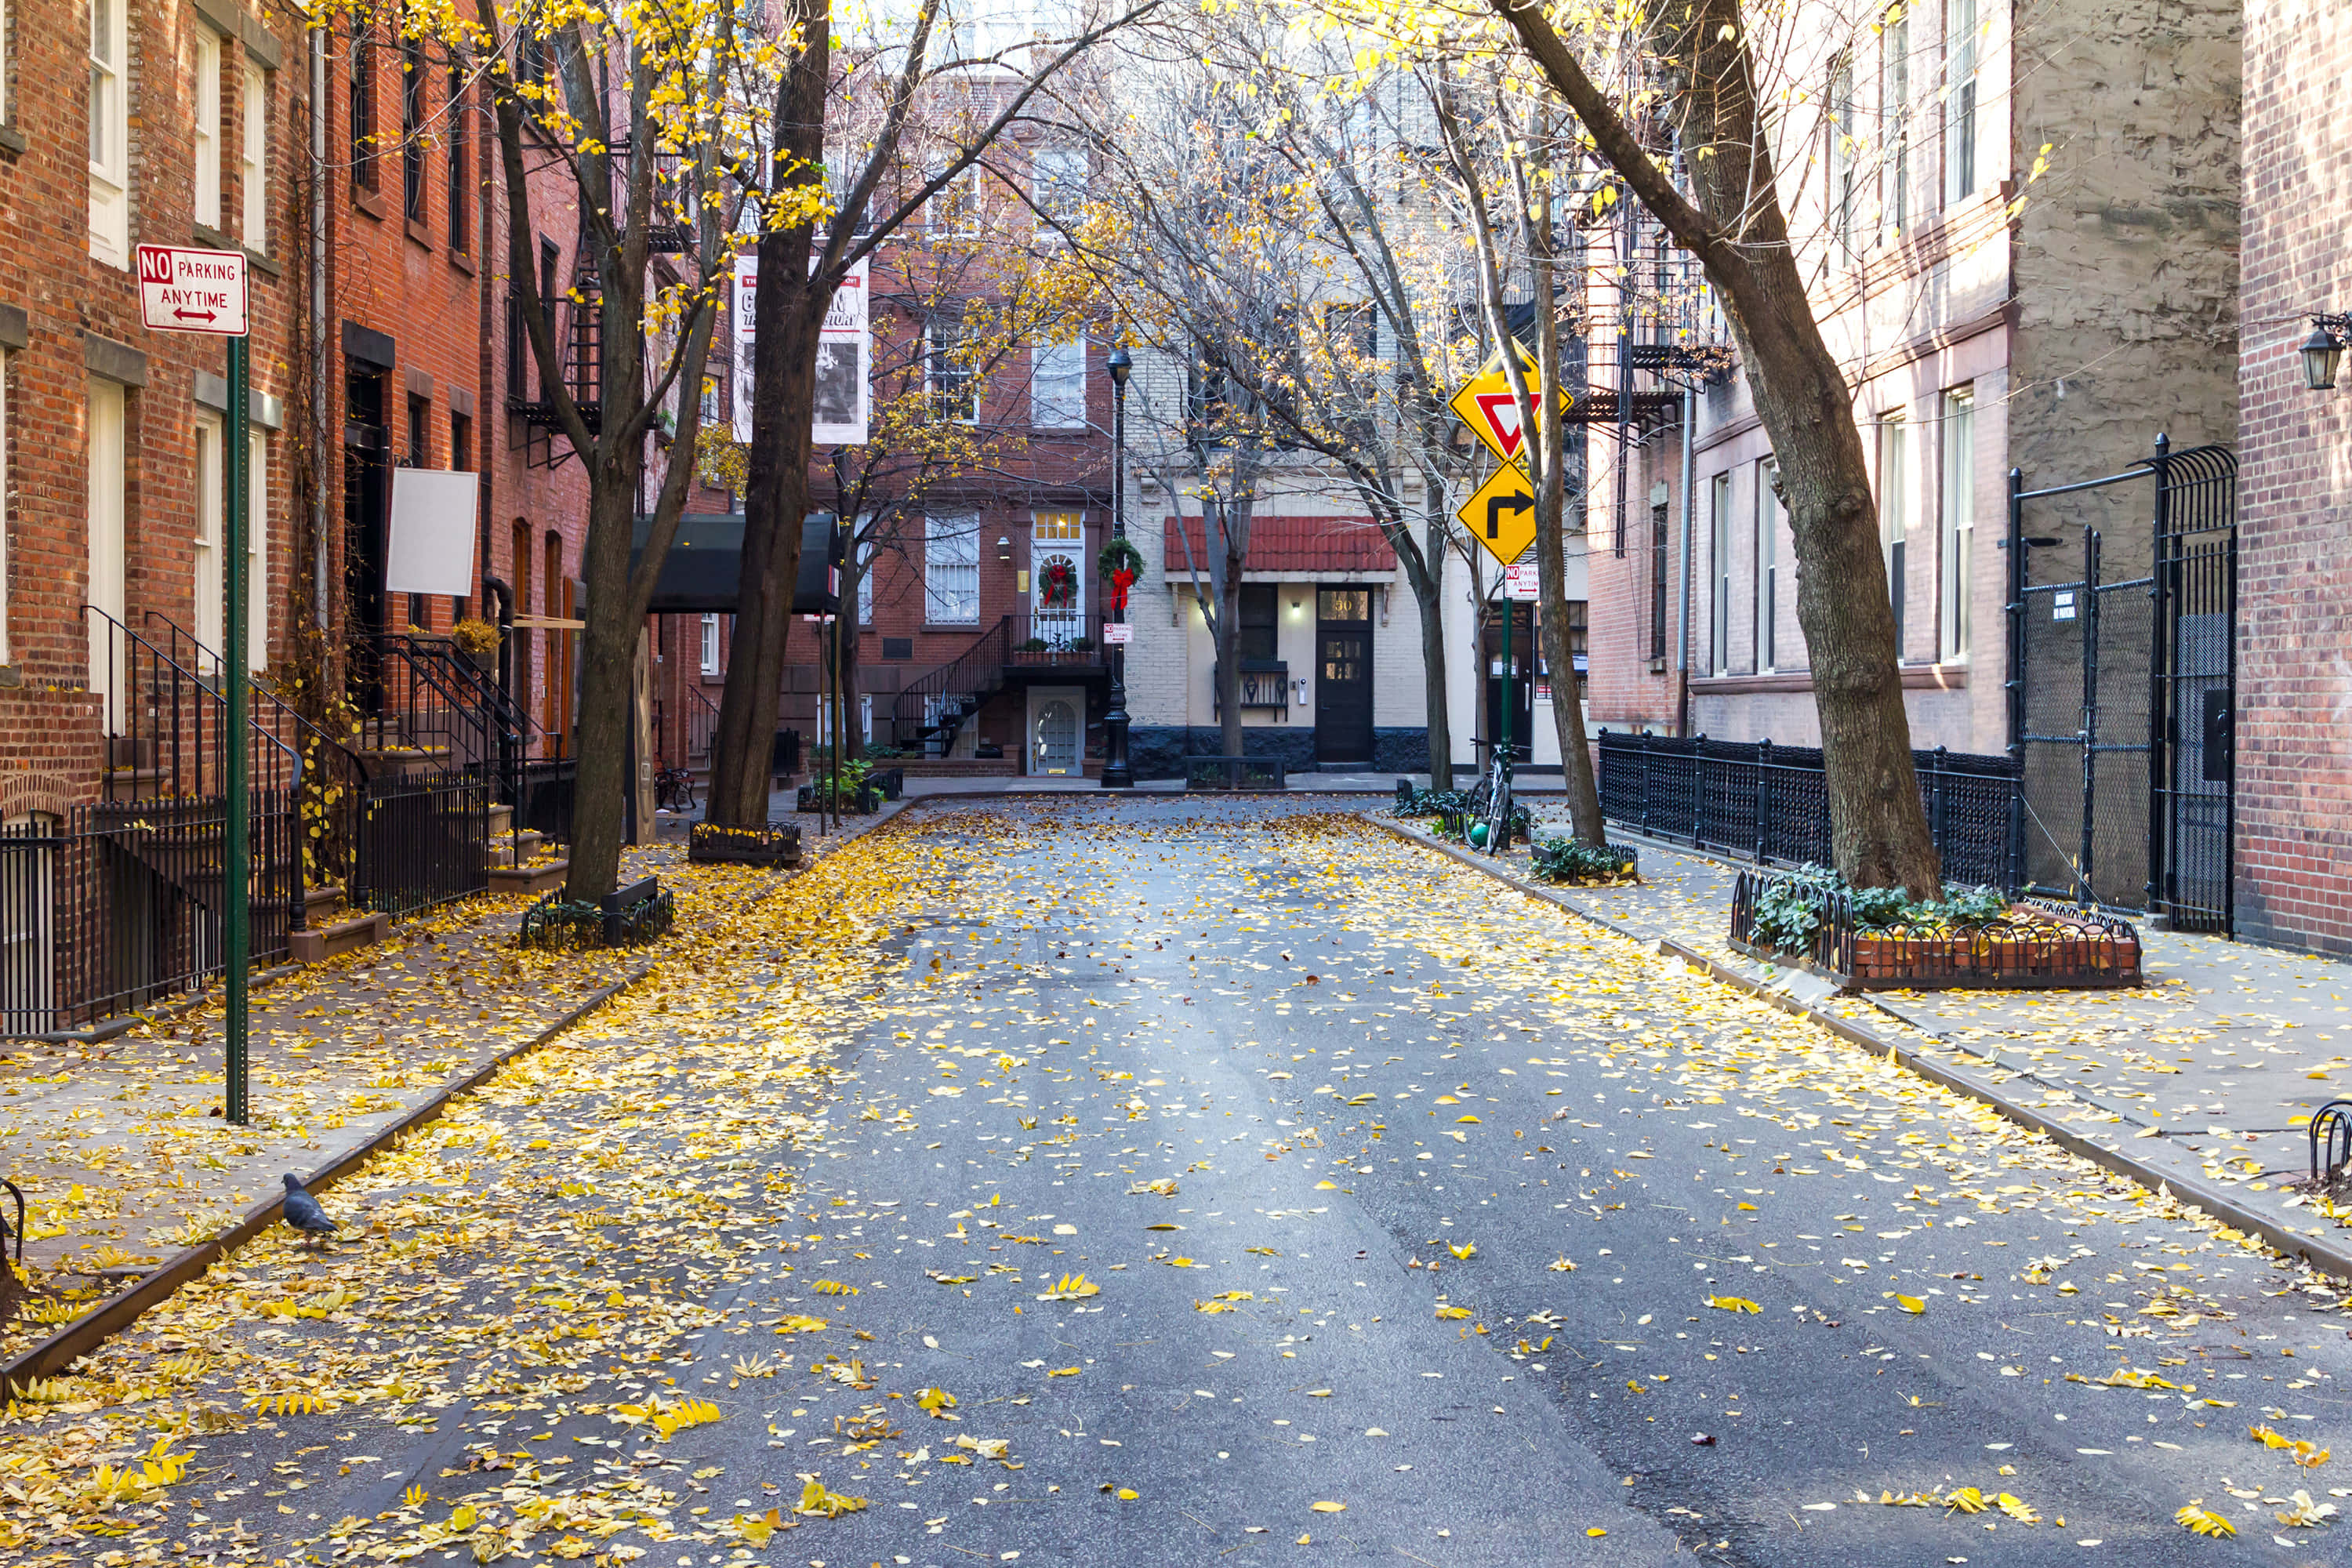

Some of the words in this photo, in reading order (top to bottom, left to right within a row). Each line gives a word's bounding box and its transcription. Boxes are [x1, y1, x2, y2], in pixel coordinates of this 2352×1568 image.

[141, 251, 170, 280] NO
[179, 261, 235, 281] PARKING
[162, 289, 227, 308] ANYTIME
[1507, 567, 1519, 578] NO
[1335, 600, 1352, 612] 50
